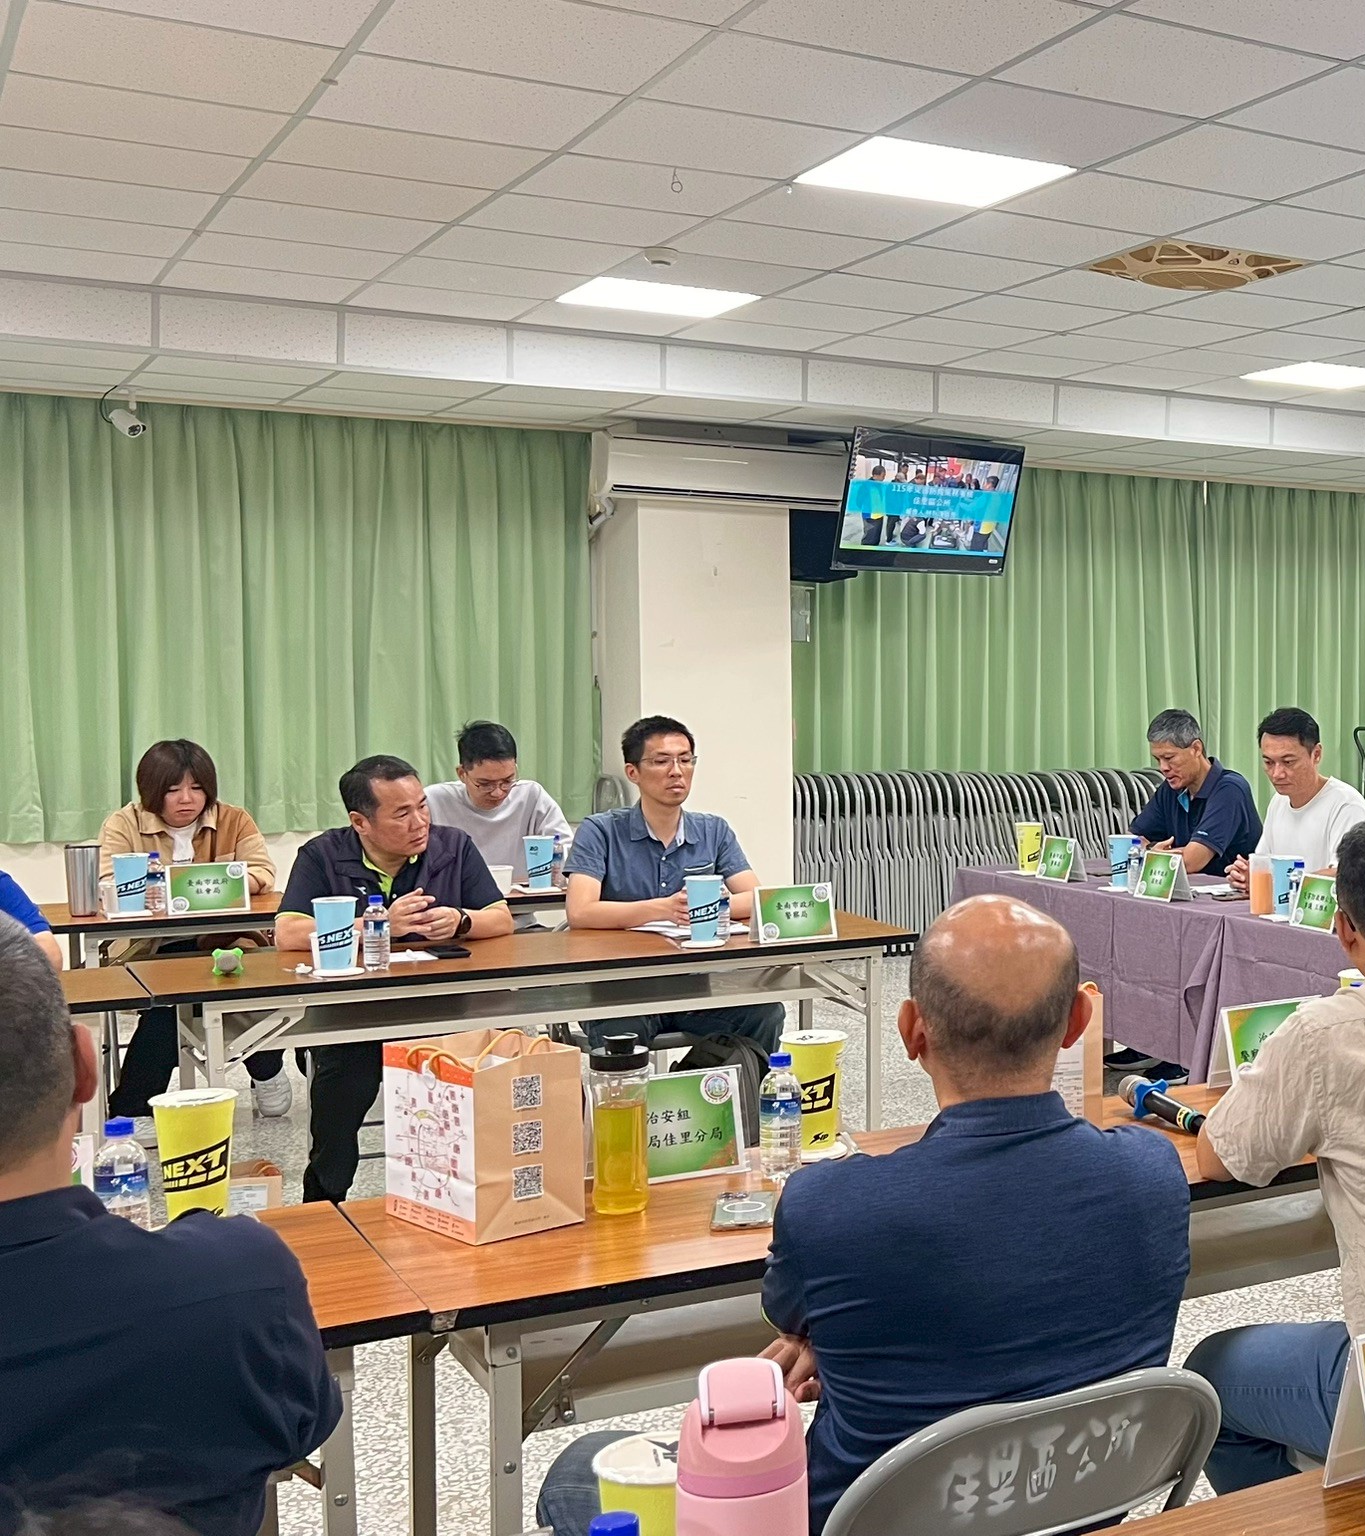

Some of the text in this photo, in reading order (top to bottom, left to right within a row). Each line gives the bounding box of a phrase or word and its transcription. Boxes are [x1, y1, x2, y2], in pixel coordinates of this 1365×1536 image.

[776, 900, 815, 911] 臺南市政府
[646, 1109, 691, 1125] 治安組
[648, 1127, 723, 1149] 局佳里分局
[164, 1144, 227, 1181] NEXT
